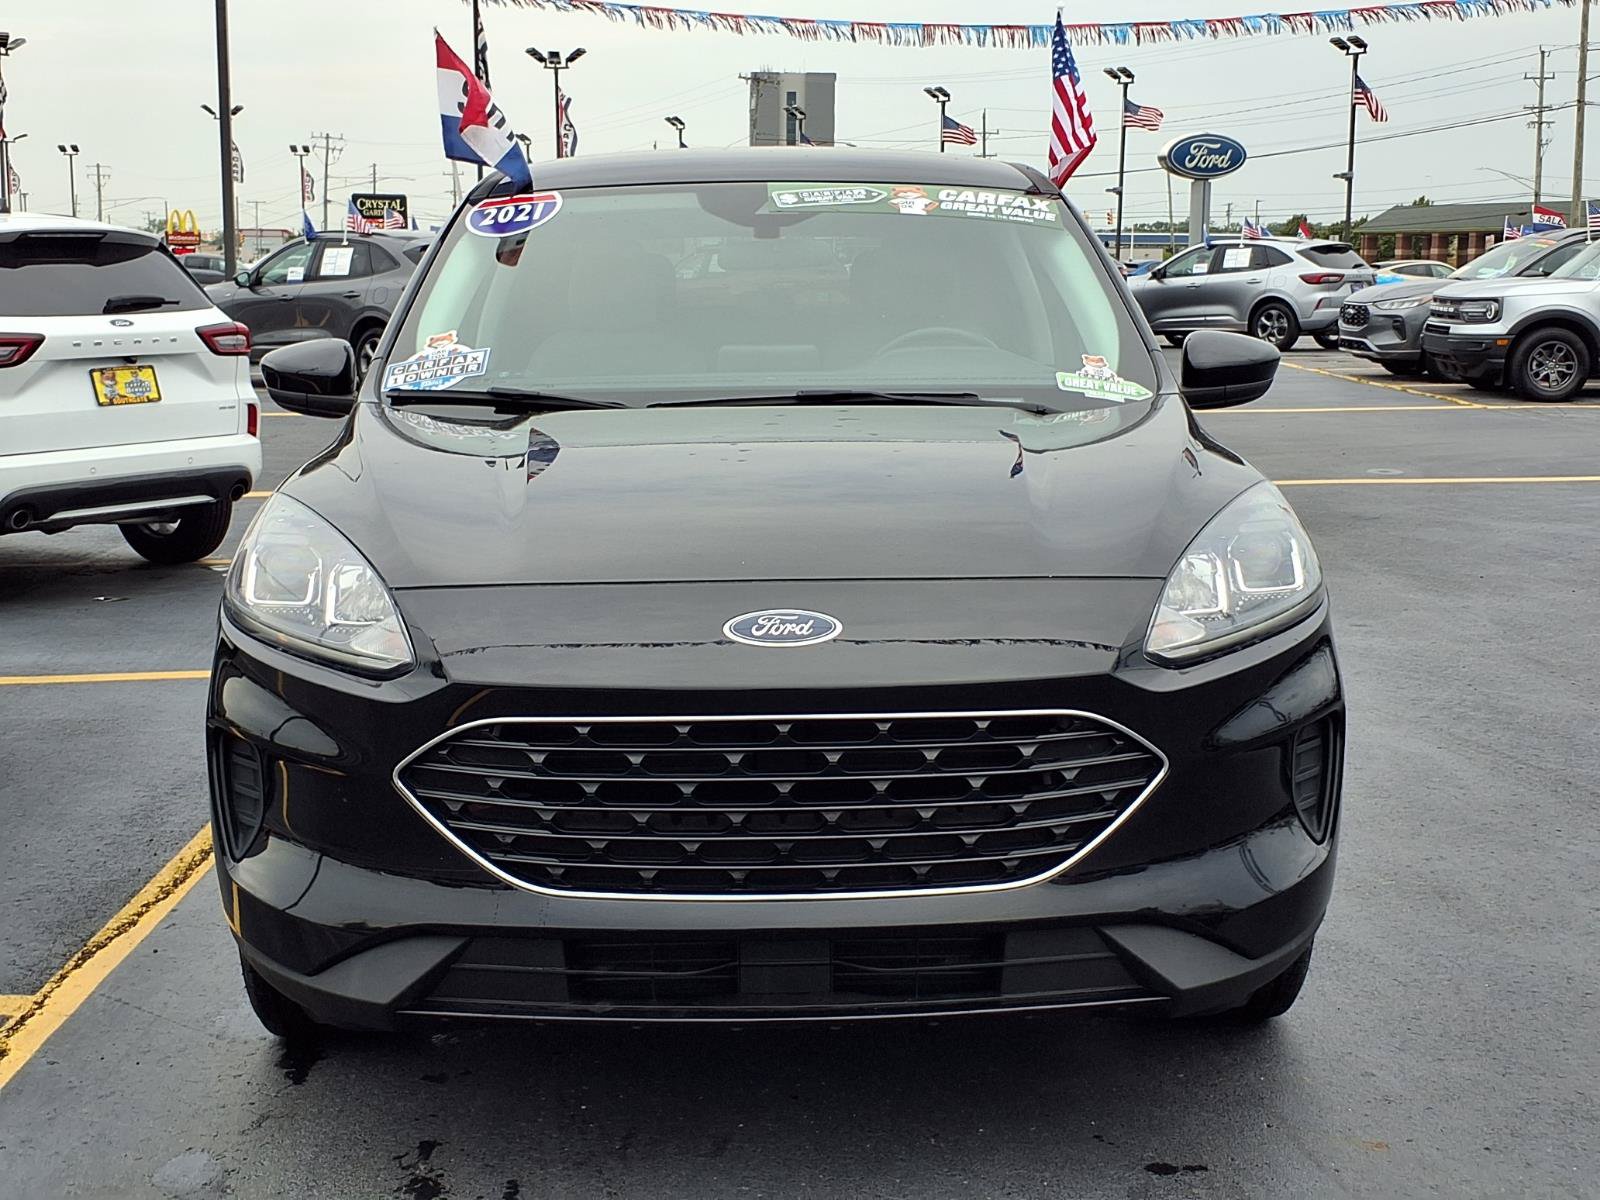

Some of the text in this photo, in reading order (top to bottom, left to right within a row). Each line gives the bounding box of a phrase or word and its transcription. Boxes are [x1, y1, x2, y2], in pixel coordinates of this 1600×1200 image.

[1185, 142, 1232, 168] Ford
[356, 198, 405, 211] CRYSTAL
[938, 190, 1050, 212] CARFAX
[940, 201, 996, 213] GREAT
[1001, 206, 1057, 222] VALUE
[479, 202, 545, 226] 2021
[392, 354, 481, 376] CARFAX
[1064, 377, 1138, 395] GREAT VALUE
[751, 615, 815, 636] Ford
